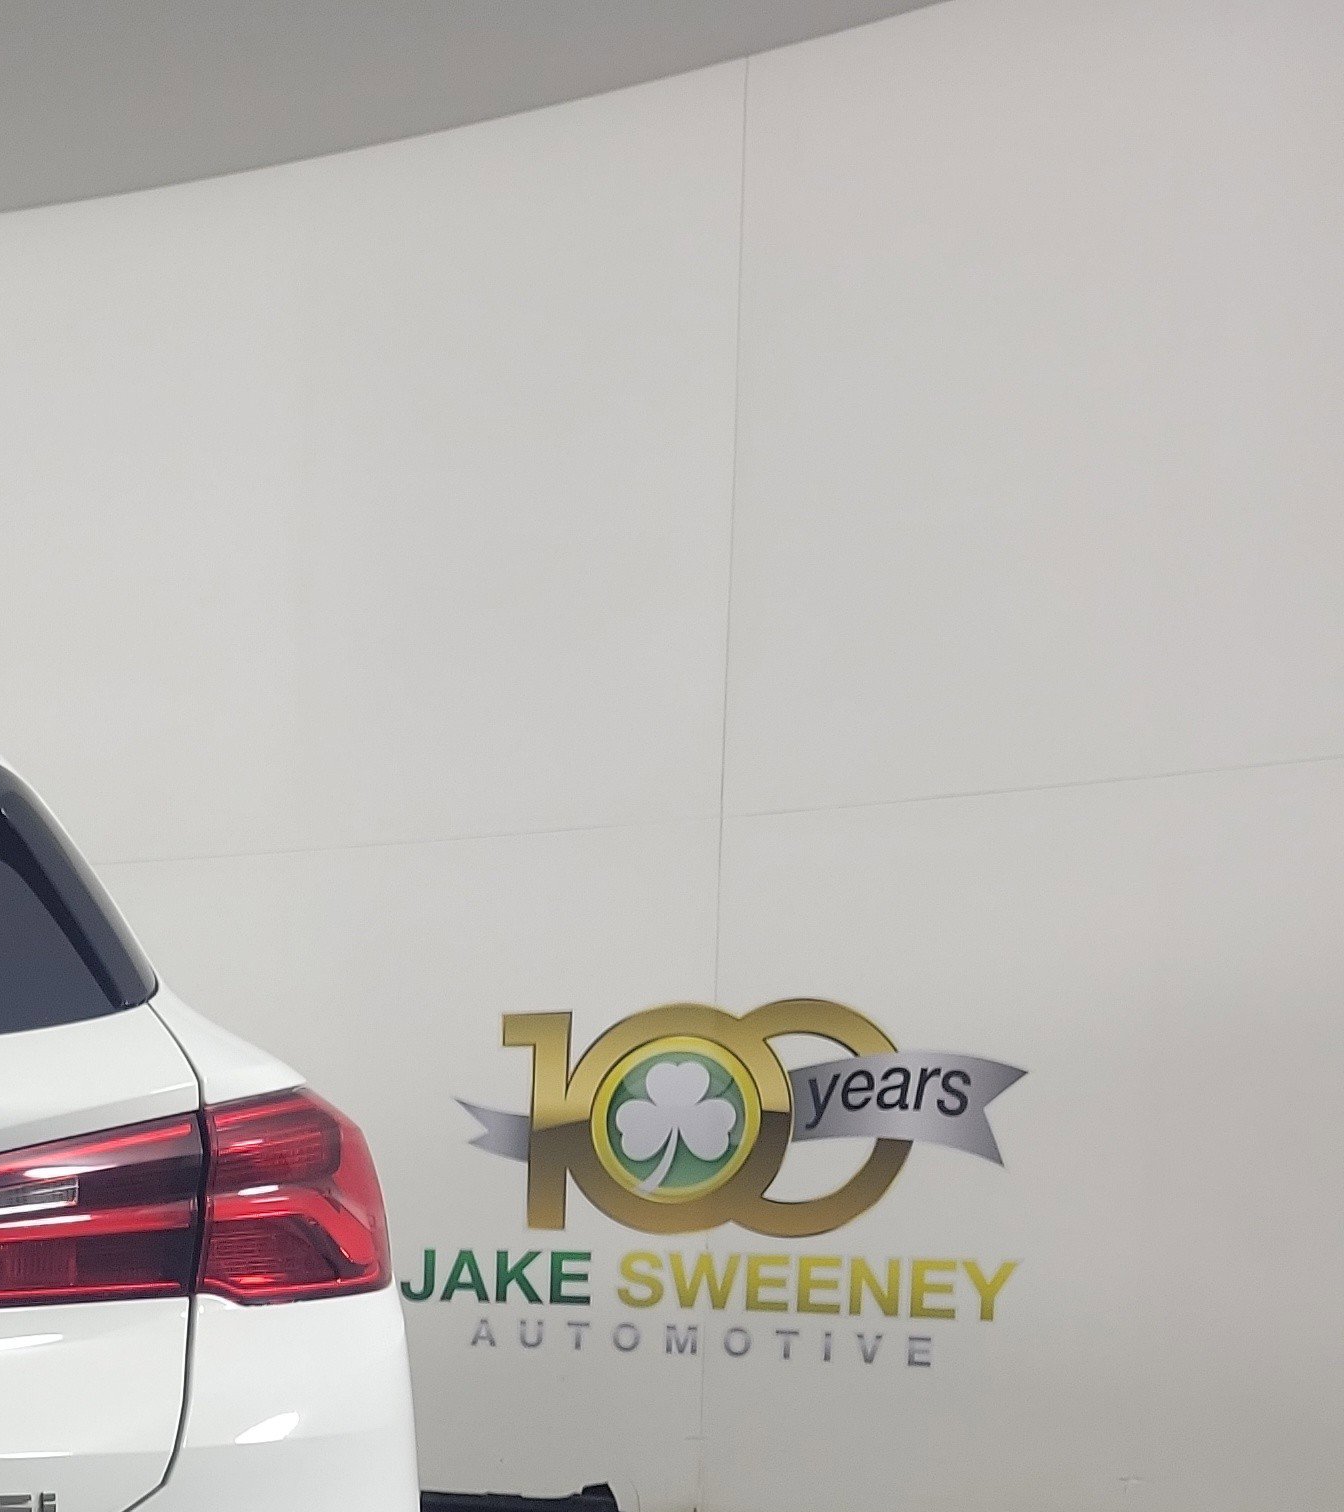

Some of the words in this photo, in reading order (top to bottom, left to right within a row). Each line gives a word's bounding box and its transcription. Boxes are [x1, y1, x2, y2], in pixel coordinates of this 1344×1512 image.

[805, 1064, 972, 1131] years
[400, 1248, 592, 1305] JAKE
[616, 1250, 1020, 1322] SWEENEY
[470, 1319, 933, 1367] AUTOMOTIVE
